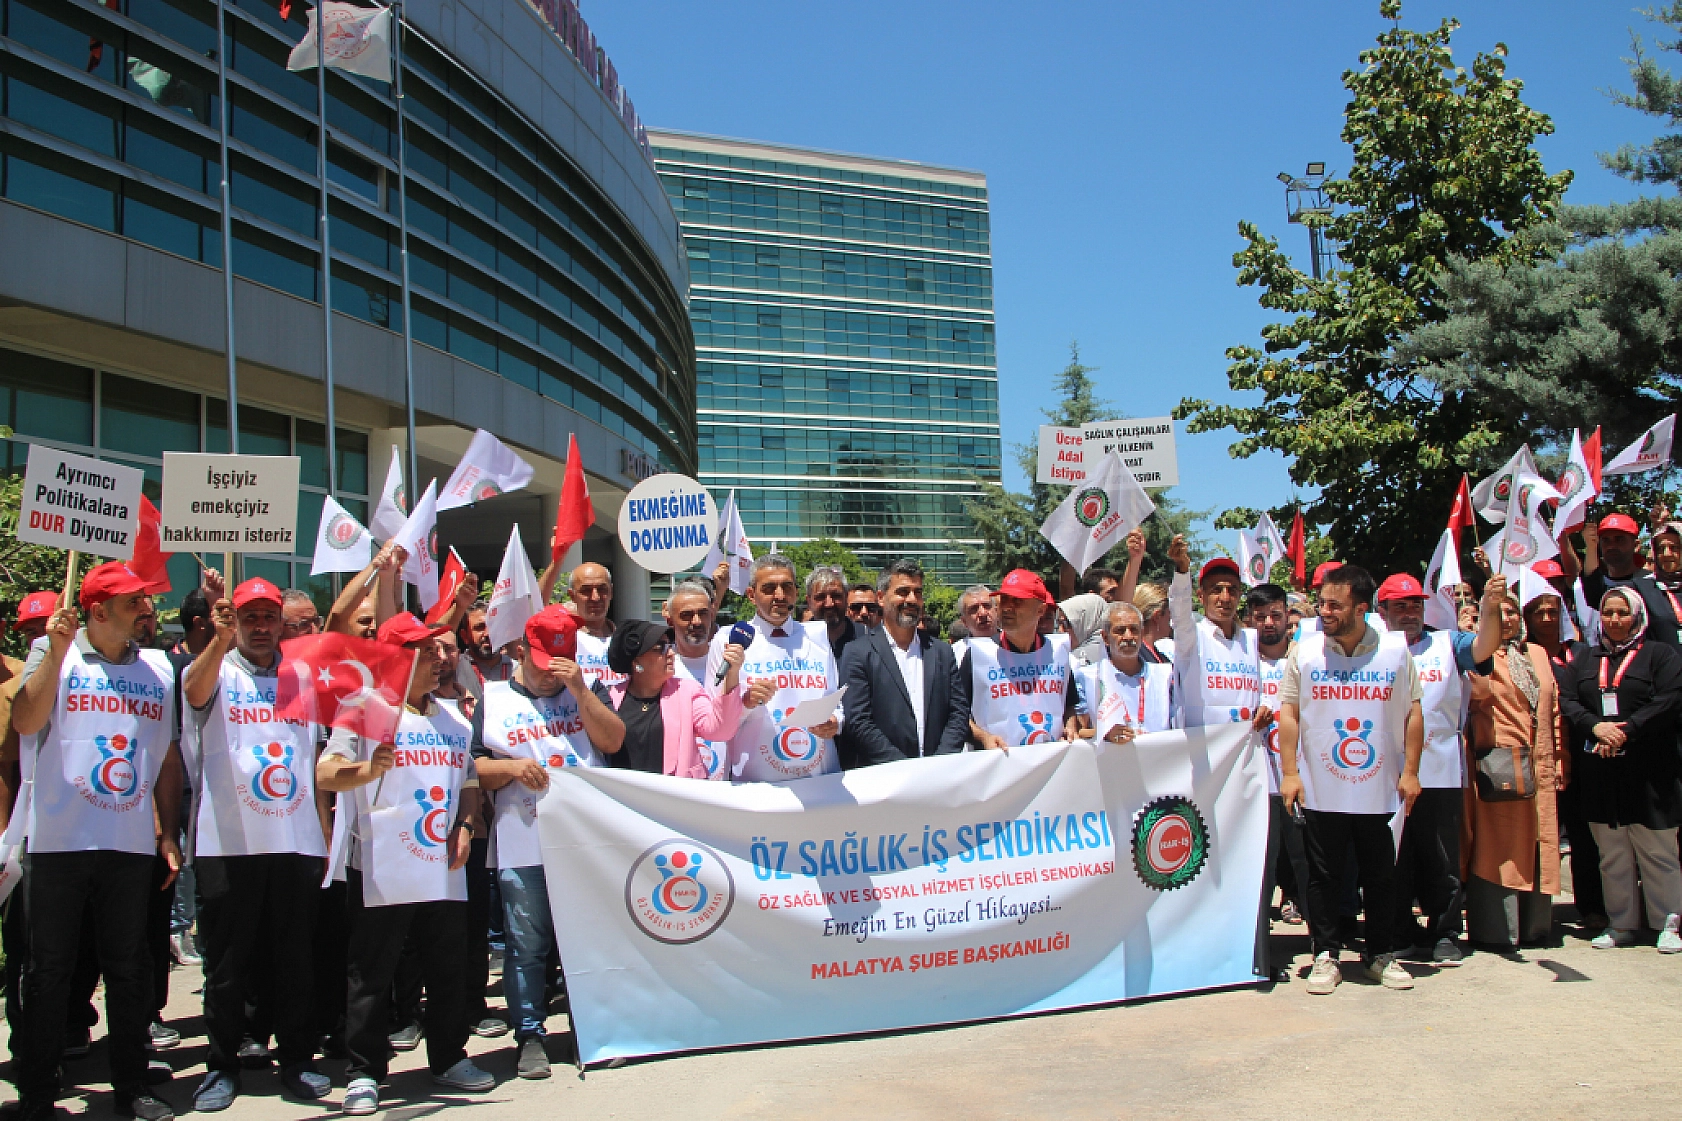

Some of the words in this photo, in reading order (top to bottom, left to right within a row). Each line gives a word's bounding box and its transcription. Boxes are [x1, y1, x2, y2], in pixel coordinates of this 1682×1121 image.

[1084, 428, 1114, 440] SAĞLIK
[1116, 424, 1171, 439] ÇALIŞANLARI
[1117, 440, 1154, 453] ÜLKENİN
[55, 462, 117, 491] Ayrımcı
[207, 466, 258, 489] İşçiyiz
[35, 484, 129, 521] Politikalara
[190, 499, 270, 519] emekçiyiz
[629, 489, 707, 522] EKMEĞİME
[29, 511, 65, 534] DUR
[69, 518, 128, 547] Diyoruz
[164, 525, 240, 543] hakkımızı
[244, 526, 292, 543] isteriz
[630, 524, 709, 553] DOKUNMA
[765, 656, 826, 677] SAĞLIK-İŞ
[988, 666, 1007, 681] ÖZ
[1009, 661, 1065, 681] SAĞLIK-İŞ
[1205, 658, 1222, 673] ÖZ
[1310, 667, 1330, 683] ÖZ
[1332, 666, 1397, 686] SAĞLIK-İŞ
[69, 672, 91, 690] ÖZ
[95, 675, 165, 703] SAĞLIK-İŞ
[1311, 682, 1394, 702] SENDİKASI
[67, 694, 165, 722] SENDİKASI
[750, 836, 793, 882] ÖZ
[798, 825, 949, 878] SAĞLIK-İŞ
[955, 811, 1111, 865] SENDİKASI
[1159, 836, 1191, 851] HAK-İŞ
[757, 892, 780, 911] ÖZ
[783, 889, 838, 909] SAĞLIK
[839, 889, 861, 905] VE
[863, 883, 920, 903] SOSYAL
[922, 877, 976, 896] HİZMET
[978, 867, 1039, 891] İŞÇİLERİ
[1040, 861, 1115, 883] SENDİKASI
[643, 908, 687, 932] SAĞLIK-İŞ
[687, 892, 724, 930] SENDİKASI
[822, 914, 888, 945] Emeğin
[893, 911, 918, 931] En
[924, 898, 972, 933] Güzel
[811, 955, 905, 980] MALATYA
[908, 949, 960, 974] ŞUBE
[963, 930, 1072, 966] BAŞKANLIĞI
